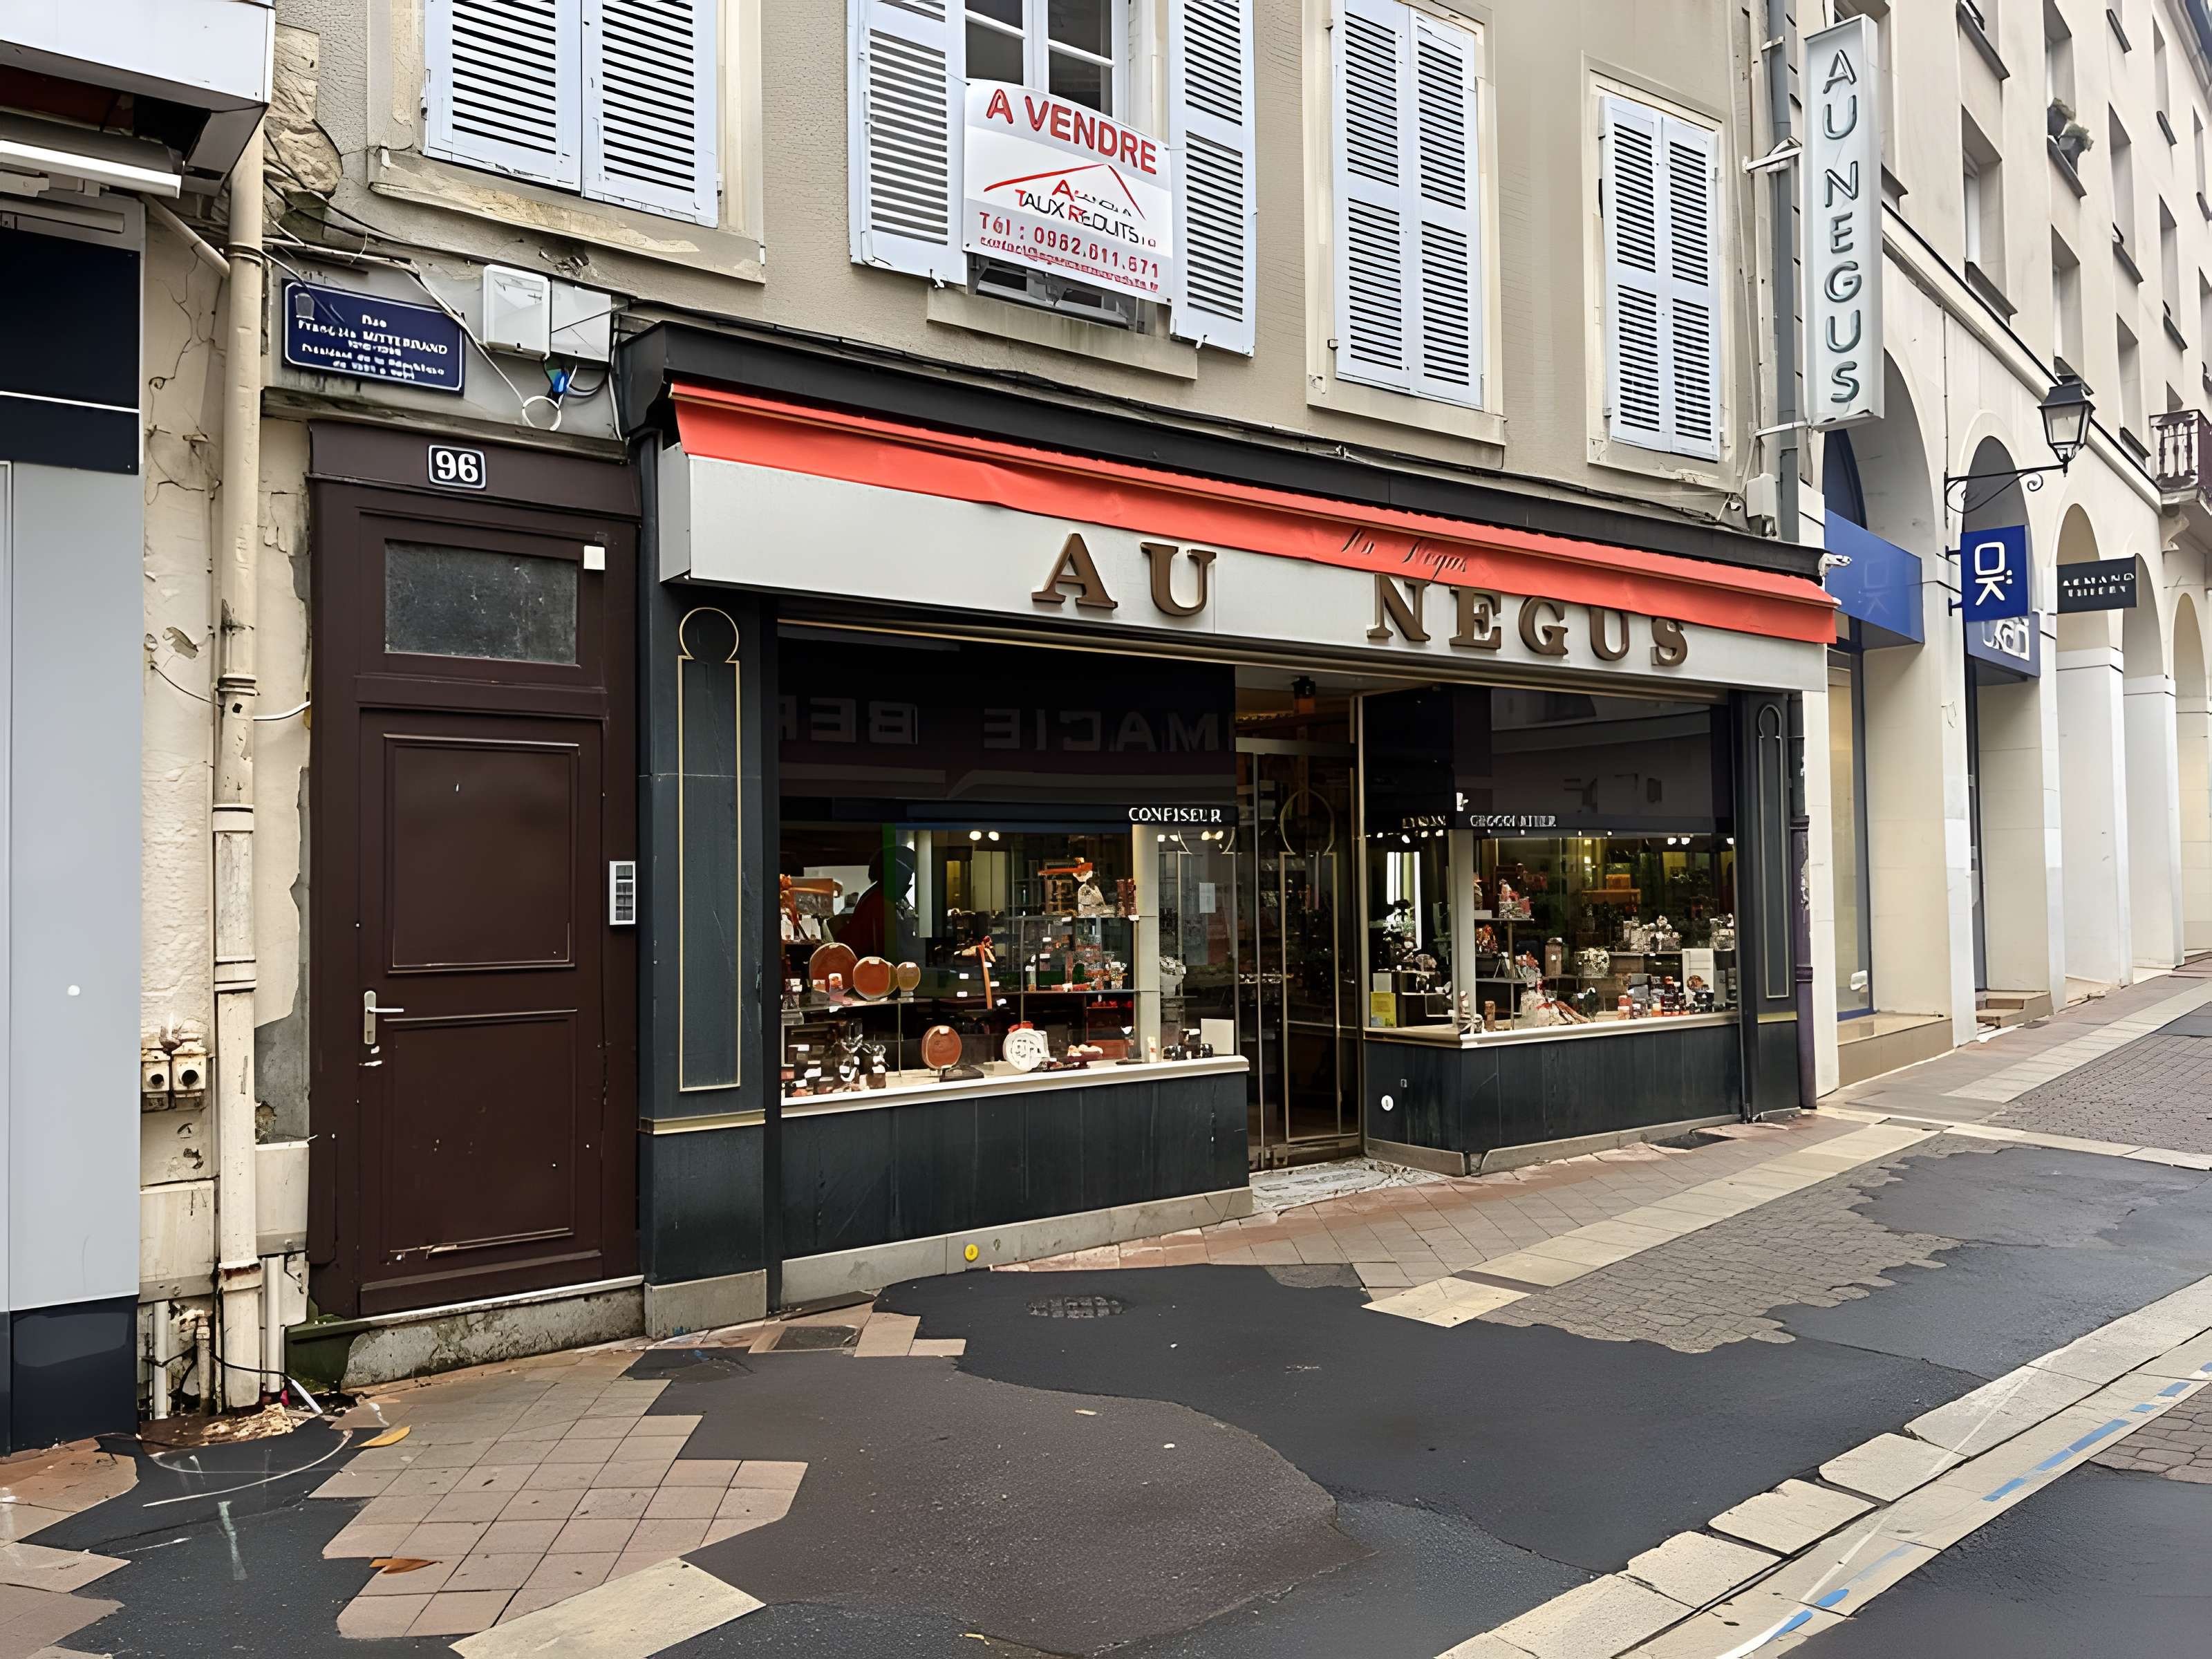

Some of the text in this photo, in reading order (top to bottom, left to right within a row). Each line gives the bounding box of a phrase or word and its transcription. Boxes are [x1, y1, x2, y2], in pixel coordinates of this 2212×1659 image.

[986, 88, 1156, 175] A VENDRE
[1822, 48, 1863, 404] AU NEGUS
[435, 451, 478, 482] 96
[1031, 532, 1689, 668] AU NEGUS
